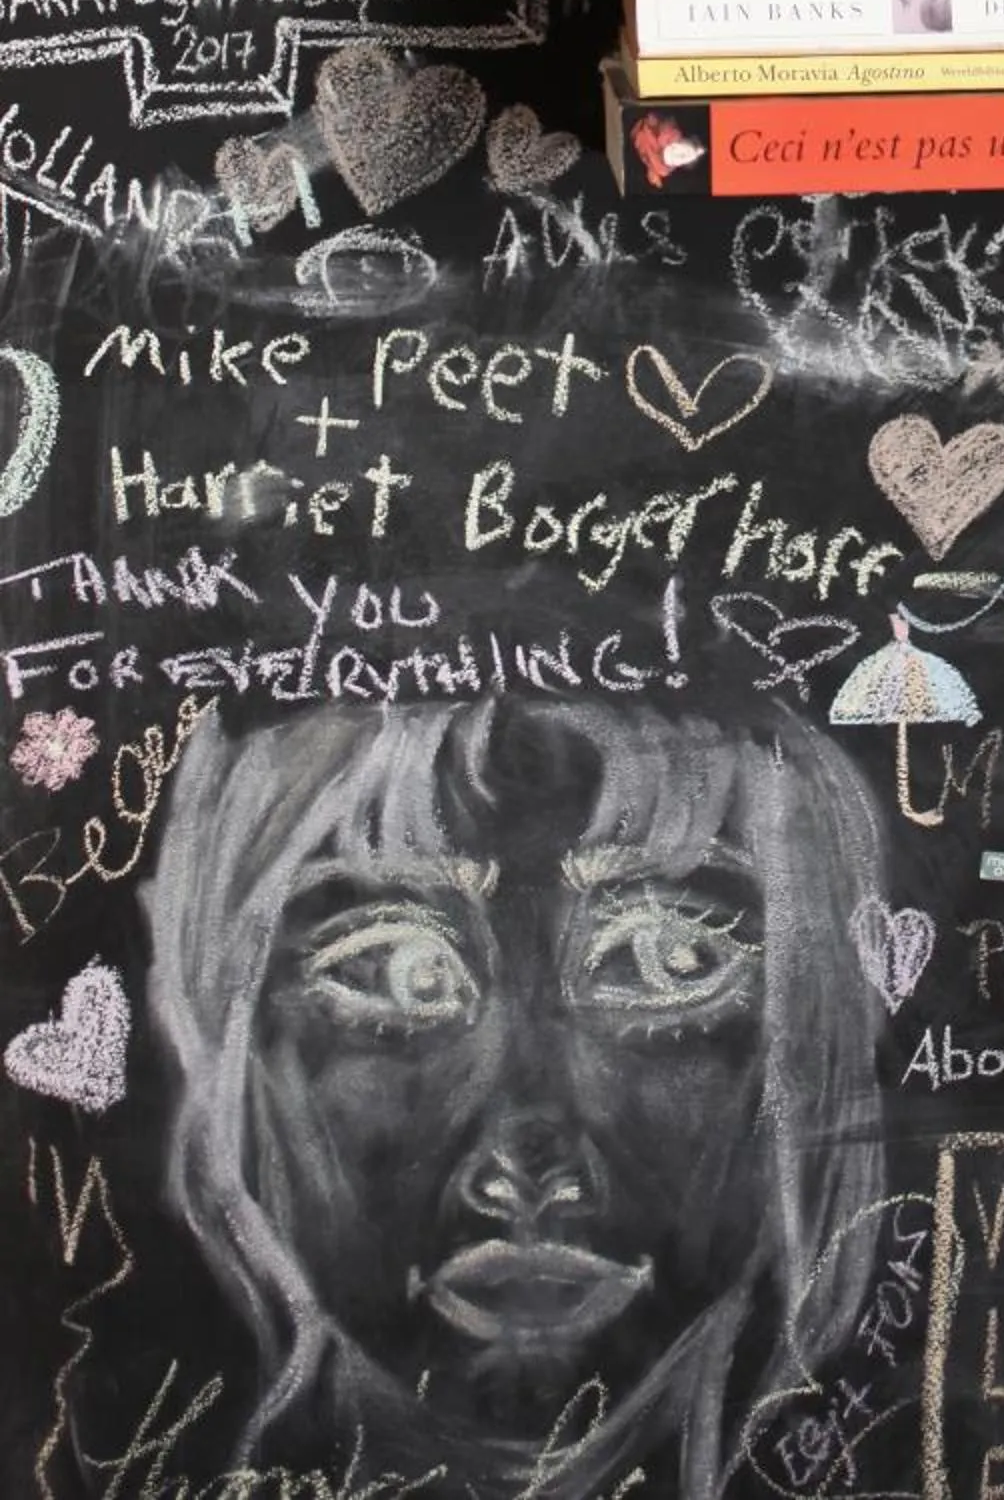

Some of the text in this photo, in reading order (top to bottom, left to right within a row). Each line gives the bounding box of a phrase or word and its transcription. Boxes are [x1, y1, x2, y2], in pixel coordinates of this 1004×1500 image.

[687, 2, 751, 23] IAIN
[767, 2, 864, 22] BANKS
[172, 22, 257, 75] 2017
[674, 64, 752, 84] Alberto
[756, 63, 838, 82] Moravia
[845, 63, 926, 86] Agostino
[729, 127, 806, 165] Ceci
[821, 127, 901, 162] n'est
[914, 133, 972, 170] pas
[83, 323, 607, 422] Mike Peet
